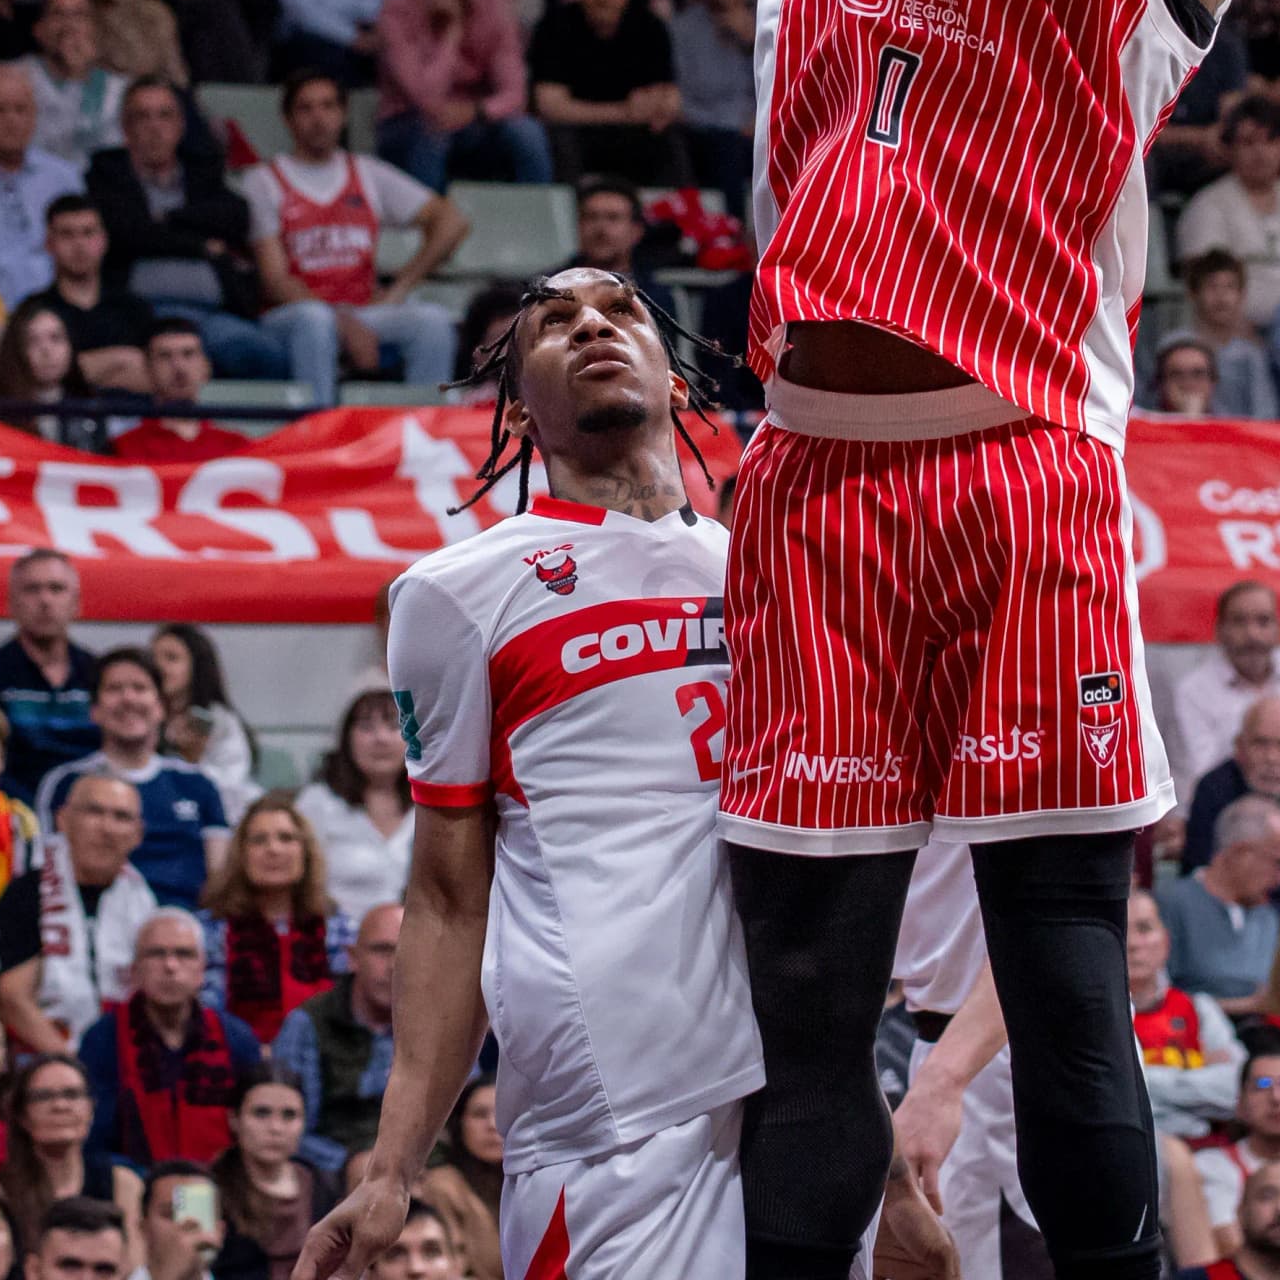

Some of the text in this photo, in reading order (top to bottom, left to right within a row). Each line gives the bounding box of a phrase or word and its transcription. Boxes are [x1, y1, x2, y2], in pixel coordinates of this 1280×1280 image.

[900, 15, 996, 57] DE MURCIA
[865, 44, 922, 149] 0
[1083, 685, 1112, 703] acb
[786, 747, 902, 784] INVERSUS
